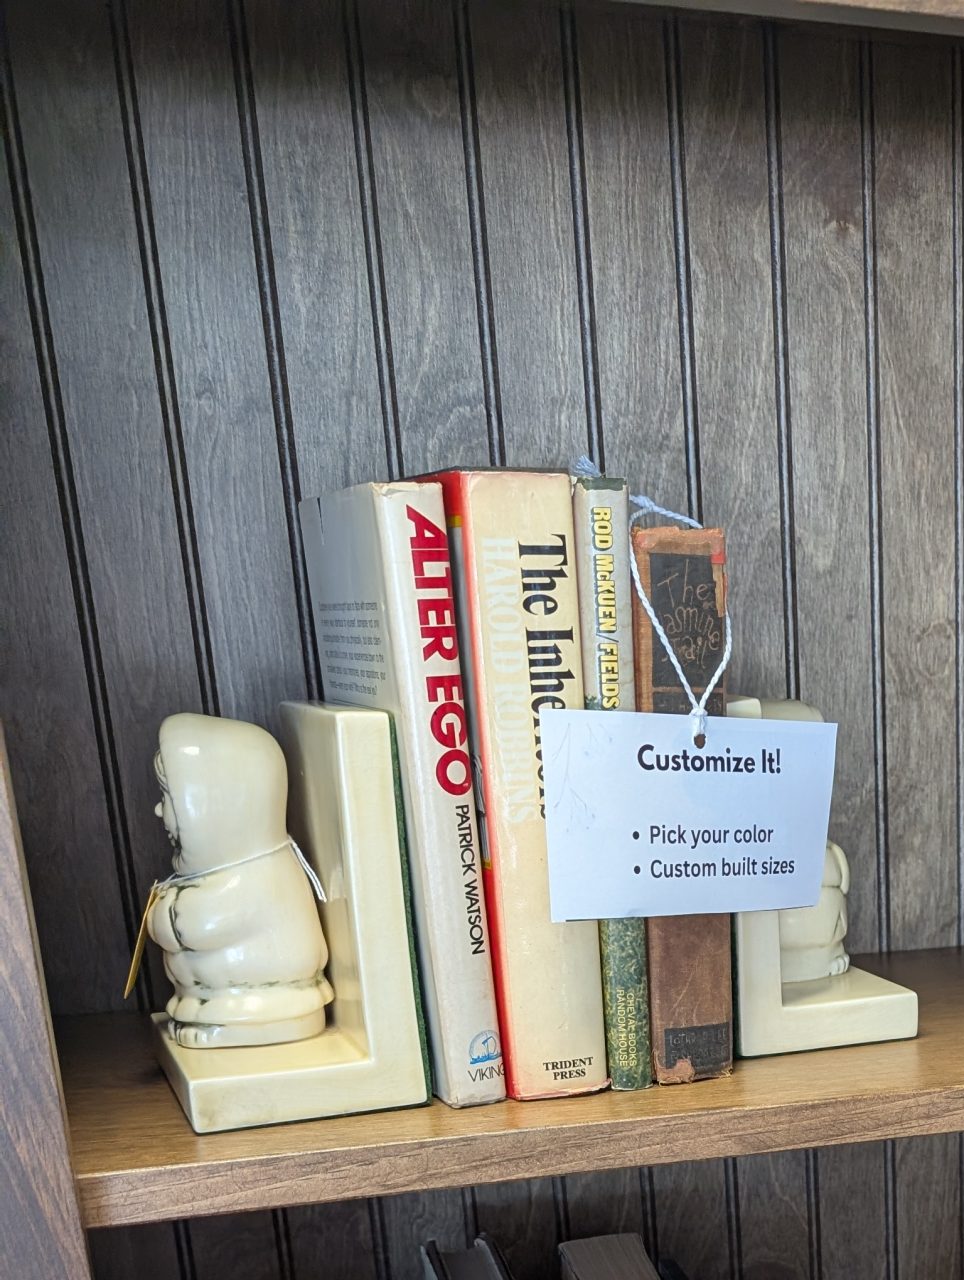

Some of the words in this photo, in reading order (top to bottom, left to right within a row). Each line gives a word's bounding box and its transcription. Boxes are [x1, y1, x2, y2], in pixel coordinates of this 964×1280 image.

[591, 506, 614, 552] ROD
[405, 503, 461, 662] ALTER
[517, 533, 570, 616] The
[657, 558, 708, 608] The
[482, 536, 527, 674] HAROLD
[425, 674, 473, 796] EGO
[637, 743, 756, 774] Customize
[760, 747, 782, 774] It!
[455, 804, 477, 876] PATRICK
[649, 825, 687, 844] Pick
[690, 828, 729, 849] your
[733, 824, 774, 843] color
[650, 859, 717, 878] Custom
[721, 857, 757, 877] built
[761, 857, 795, 875] sizes
[464, 878, 486, 955] WATSON
[616, 986, 627, 1032] RANDOM
[543, 1056, 594, 1072] TRIDENT
[618, 1034, 629, 1068] HOUSE
[628, 1033, 638, 1067] BOOKS
[553, 1068, 586, 1081] PRESS
